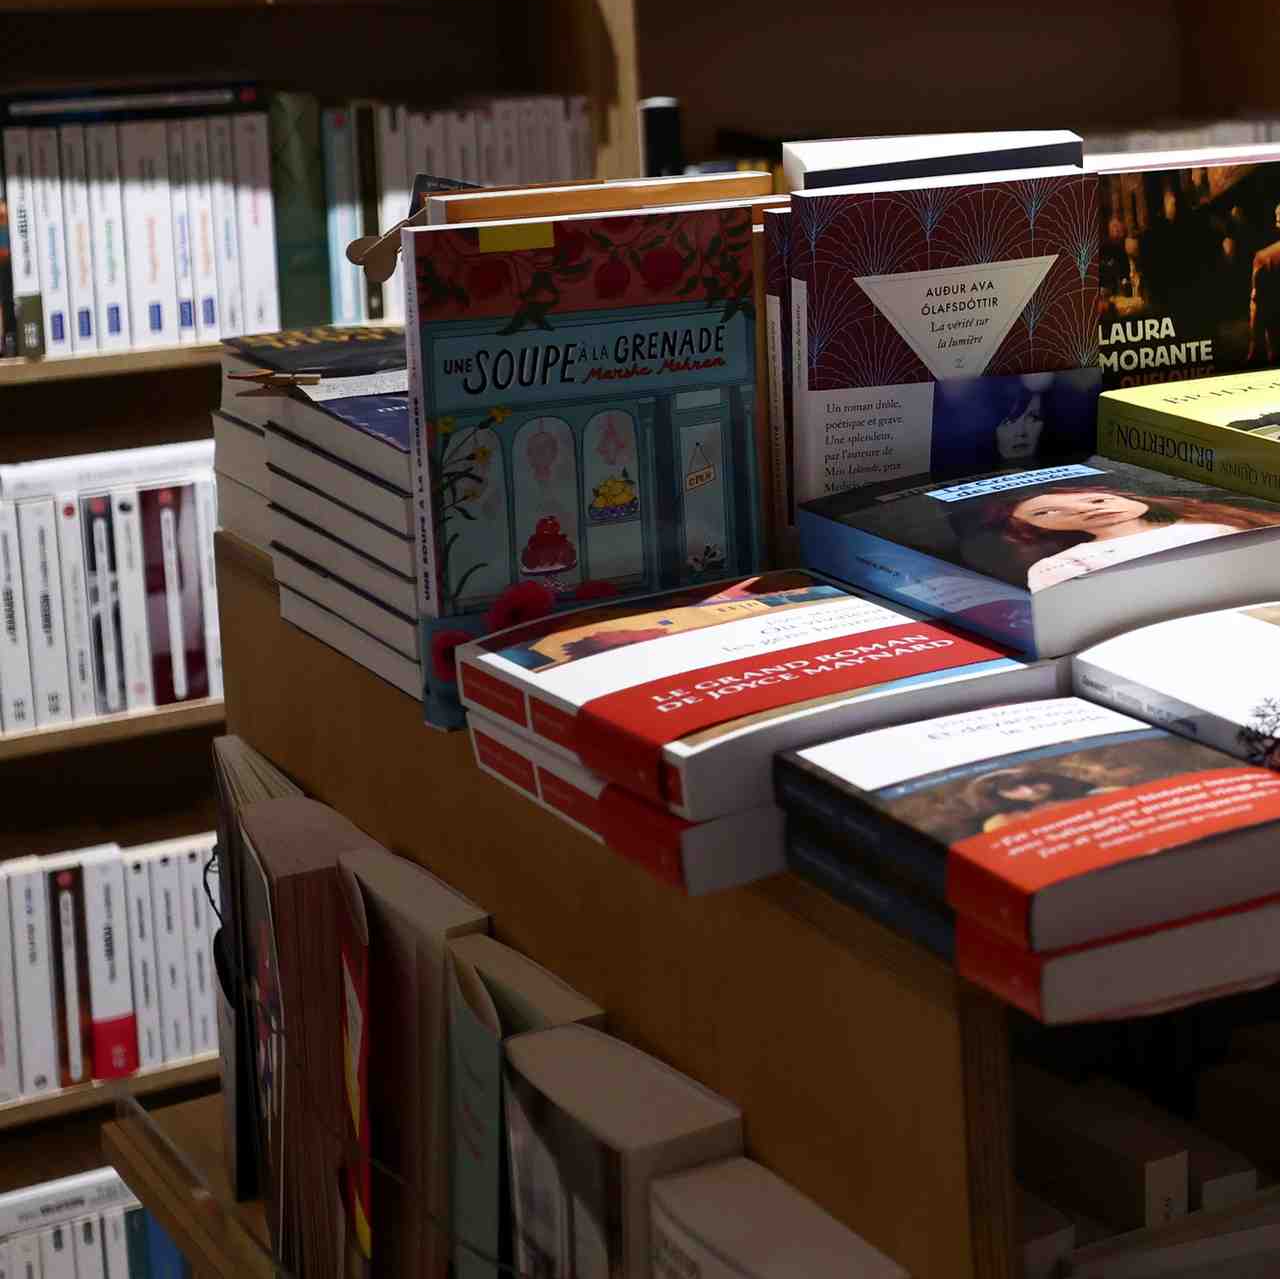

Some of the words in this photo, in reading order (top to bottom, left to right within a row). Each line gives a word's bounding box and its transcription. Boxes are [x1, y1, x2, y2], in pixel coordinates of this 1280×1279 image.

[970, 281, 994, 295] AVA
[1098, 317, 1177, 346] LAURA
[444, 359, 473, 375] UNE
[463, 342, 578, 395] SOUPE
[592, 344, 609, 361] LA
[614, 324, 726, 365] GRENADE
[1098, 340, 1214, 373] MORANTE
[827, 403, 842, 414] Un
[844, 403, 874, 414] roman
[1115, 423, 1216, 473] BRIDGERTON
[688, 472, 712, 487] OPEN
[650, 687, 691, 703] LE
[694, 659, 810, 693] GRAND
[813, 633, 930, 663] ROMAN
[656, 697, 703, 713] DE
[707, 673, 801, 700] JOYCE
[802, 639, 956, 676] MAYNARD
